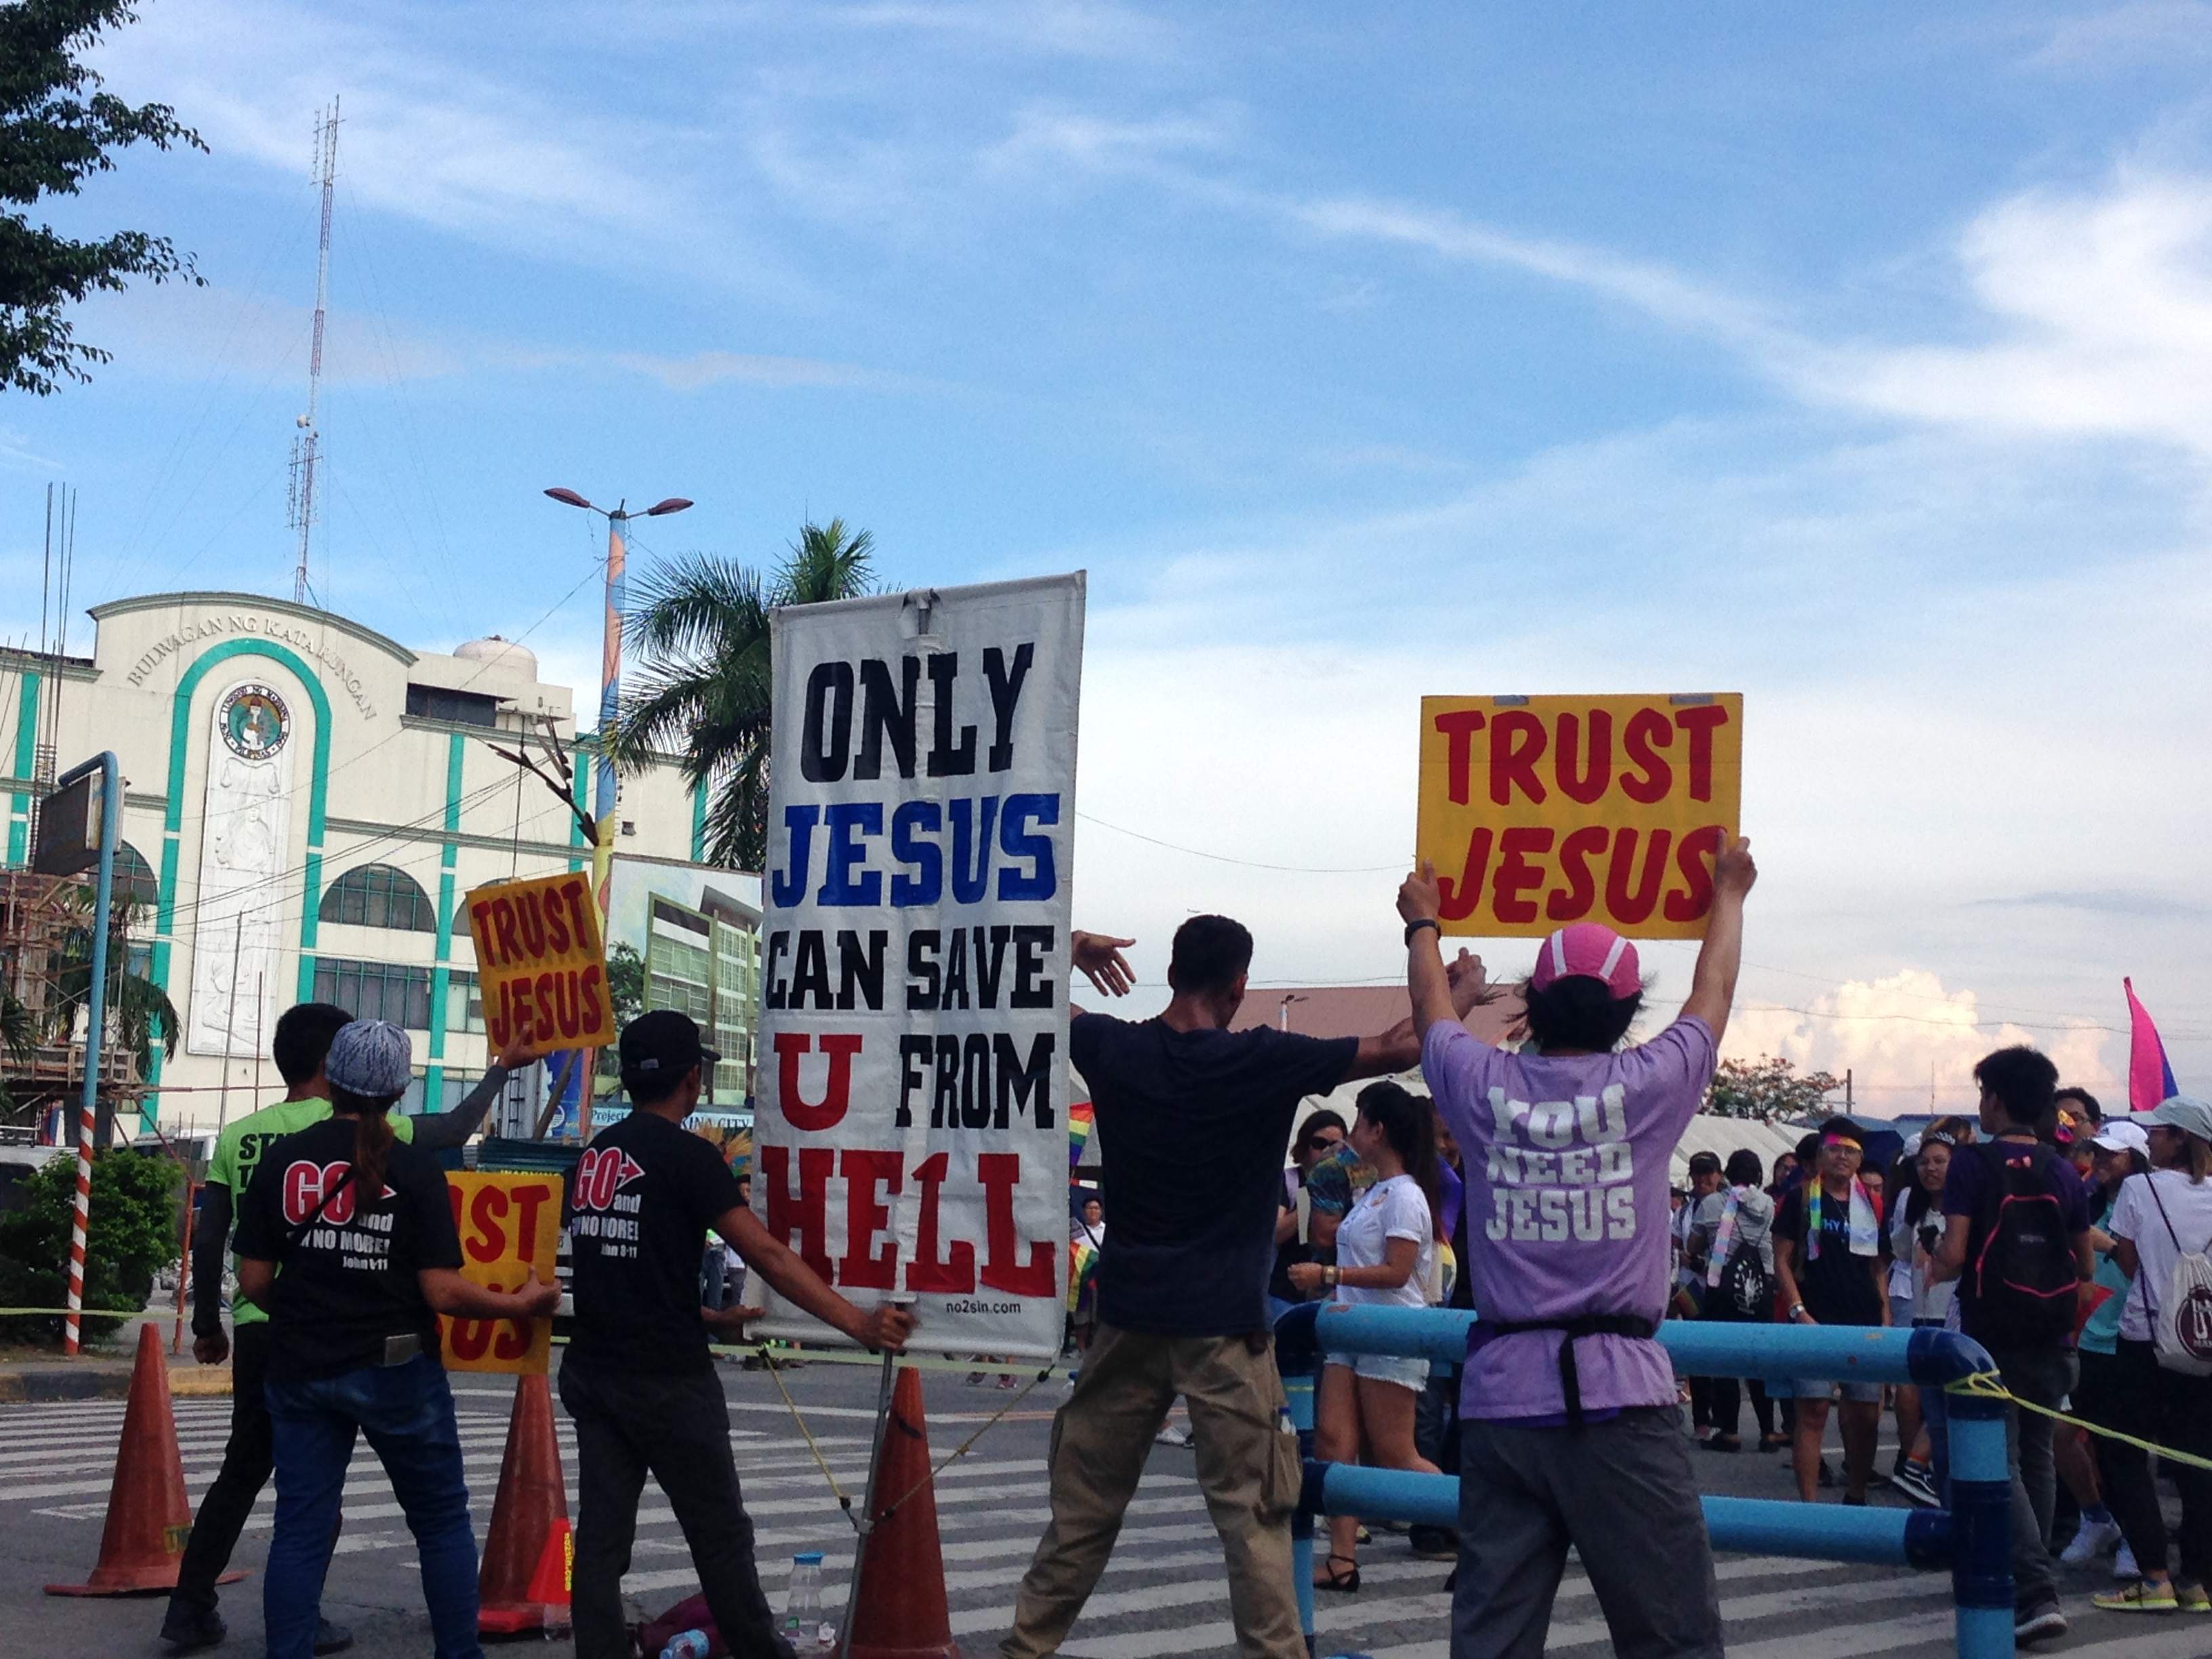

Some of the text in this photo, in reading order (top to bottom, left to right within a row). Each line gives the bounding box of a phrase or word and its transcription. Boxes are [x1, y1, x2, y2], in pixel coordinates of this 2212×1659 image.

[228, 614, 258, 633] NG
[800, 642, 1035, 783] ONLY
[1434, 705, 1729, 806] TRUST
[771, 792, 1061, 908] JESUS
[1436, 825, 1728, 924] JESUS
[471, 879, 589, 967] TRUST
[765, 924, 1055, 1011] CAN SAVE
[491, 964, 602, 1048] JESUS
[773, 1032, 1056, 1132] U FROM
[1487, 1083, 1627, 1149] YOU
[283, 1160, 356, 1226] GO
[571, 1147, 622, 1212] GO
[1484, 1141, 1633, 1183] NEED
[581, 1214, 599, 1237] NO
[613, 1193, 641, 1214] and
[760, 1145, 1057, 1298] HELL
[1486, 1185, 1637, 1242] JESUS
[312, 1229, 337, 1250] NO
[946, 1299, 1021, 1313] no2sin.com
